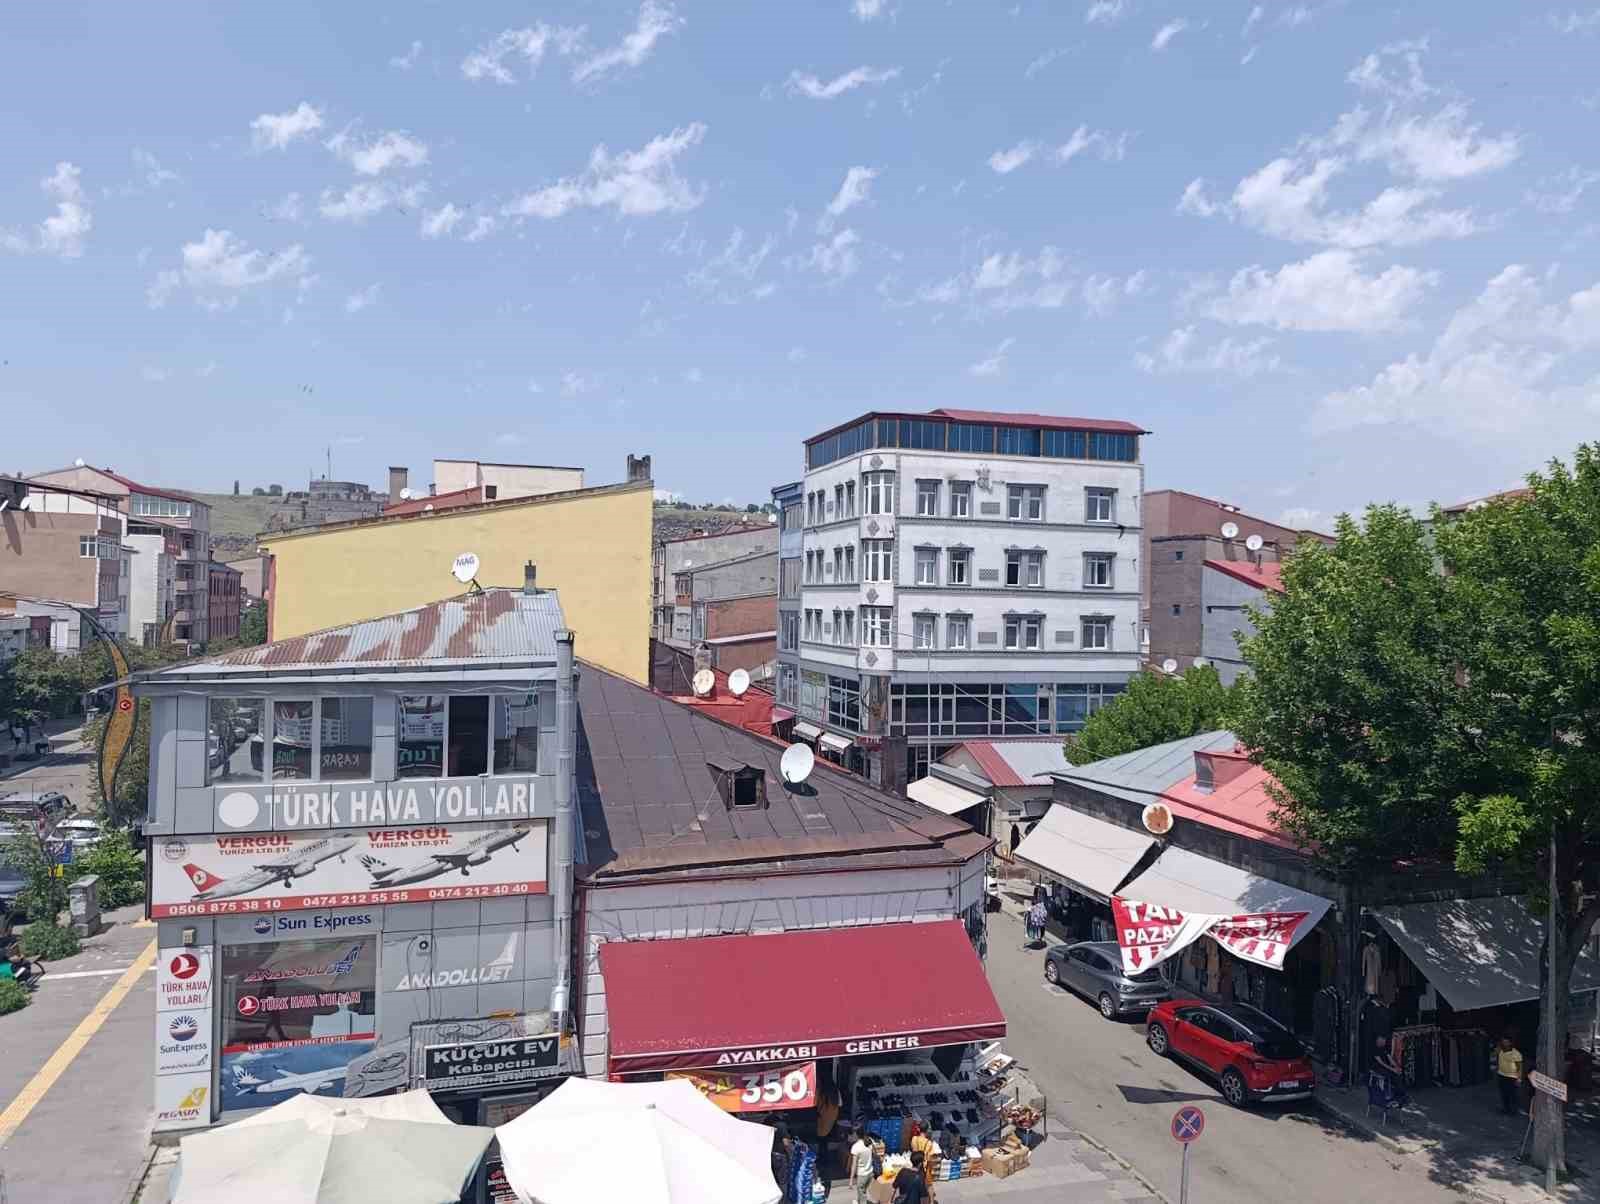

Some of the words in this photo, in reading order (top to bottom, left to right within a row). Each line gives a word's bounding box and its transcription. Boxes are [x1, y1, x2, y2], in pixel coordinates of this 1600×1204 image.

[265, 787, 340, 827] TÜRK
[350, 788, 420, 823] HAVA
[430, 782, 536, 818] YOLLARI
[217, 835, 293, 848] VERGÜL
[368, 827, 452, 842] VERGÜL
[370, 840, 408, 849] TURİZM
[303, 896, 337, 907] 0474
[343, 894, 367, 904] 212
[371, 893, 388, 903] 55
[391, 891, 409, 901] 55
[428, 887, 461, 899] 0474
[466, 886, 489, 897] 212
[492, 884, 509, 895] 40
[511, 883, 529, 894] 40
[169, 904, 205, 915] 0506
[210, 902, 237, 913] 875
[242, 900, 259, 911] 38
[264, 899, 281, 910] 10
[278, 916, 307, 930] Sun
[314, 913, 372, 932] Express
[394, 965, 513, 991] ANADOLUJET
[161, 983, 184, 992] TÜRK
[186, 981, 208, 991] HAVA
[260, 996, 289, 1012] TÜRK
[159, 1043, 208, 1055] SunExpress
[433, 1043, 516, 1064] KÜÇÜK
[524, 1039, 553, 1053] EV
[717, 1047, 817, 1065] AYAKKABI
[846, 1036, 919, 1053] CENTER
[740, 1072, 808, 1104] 350
